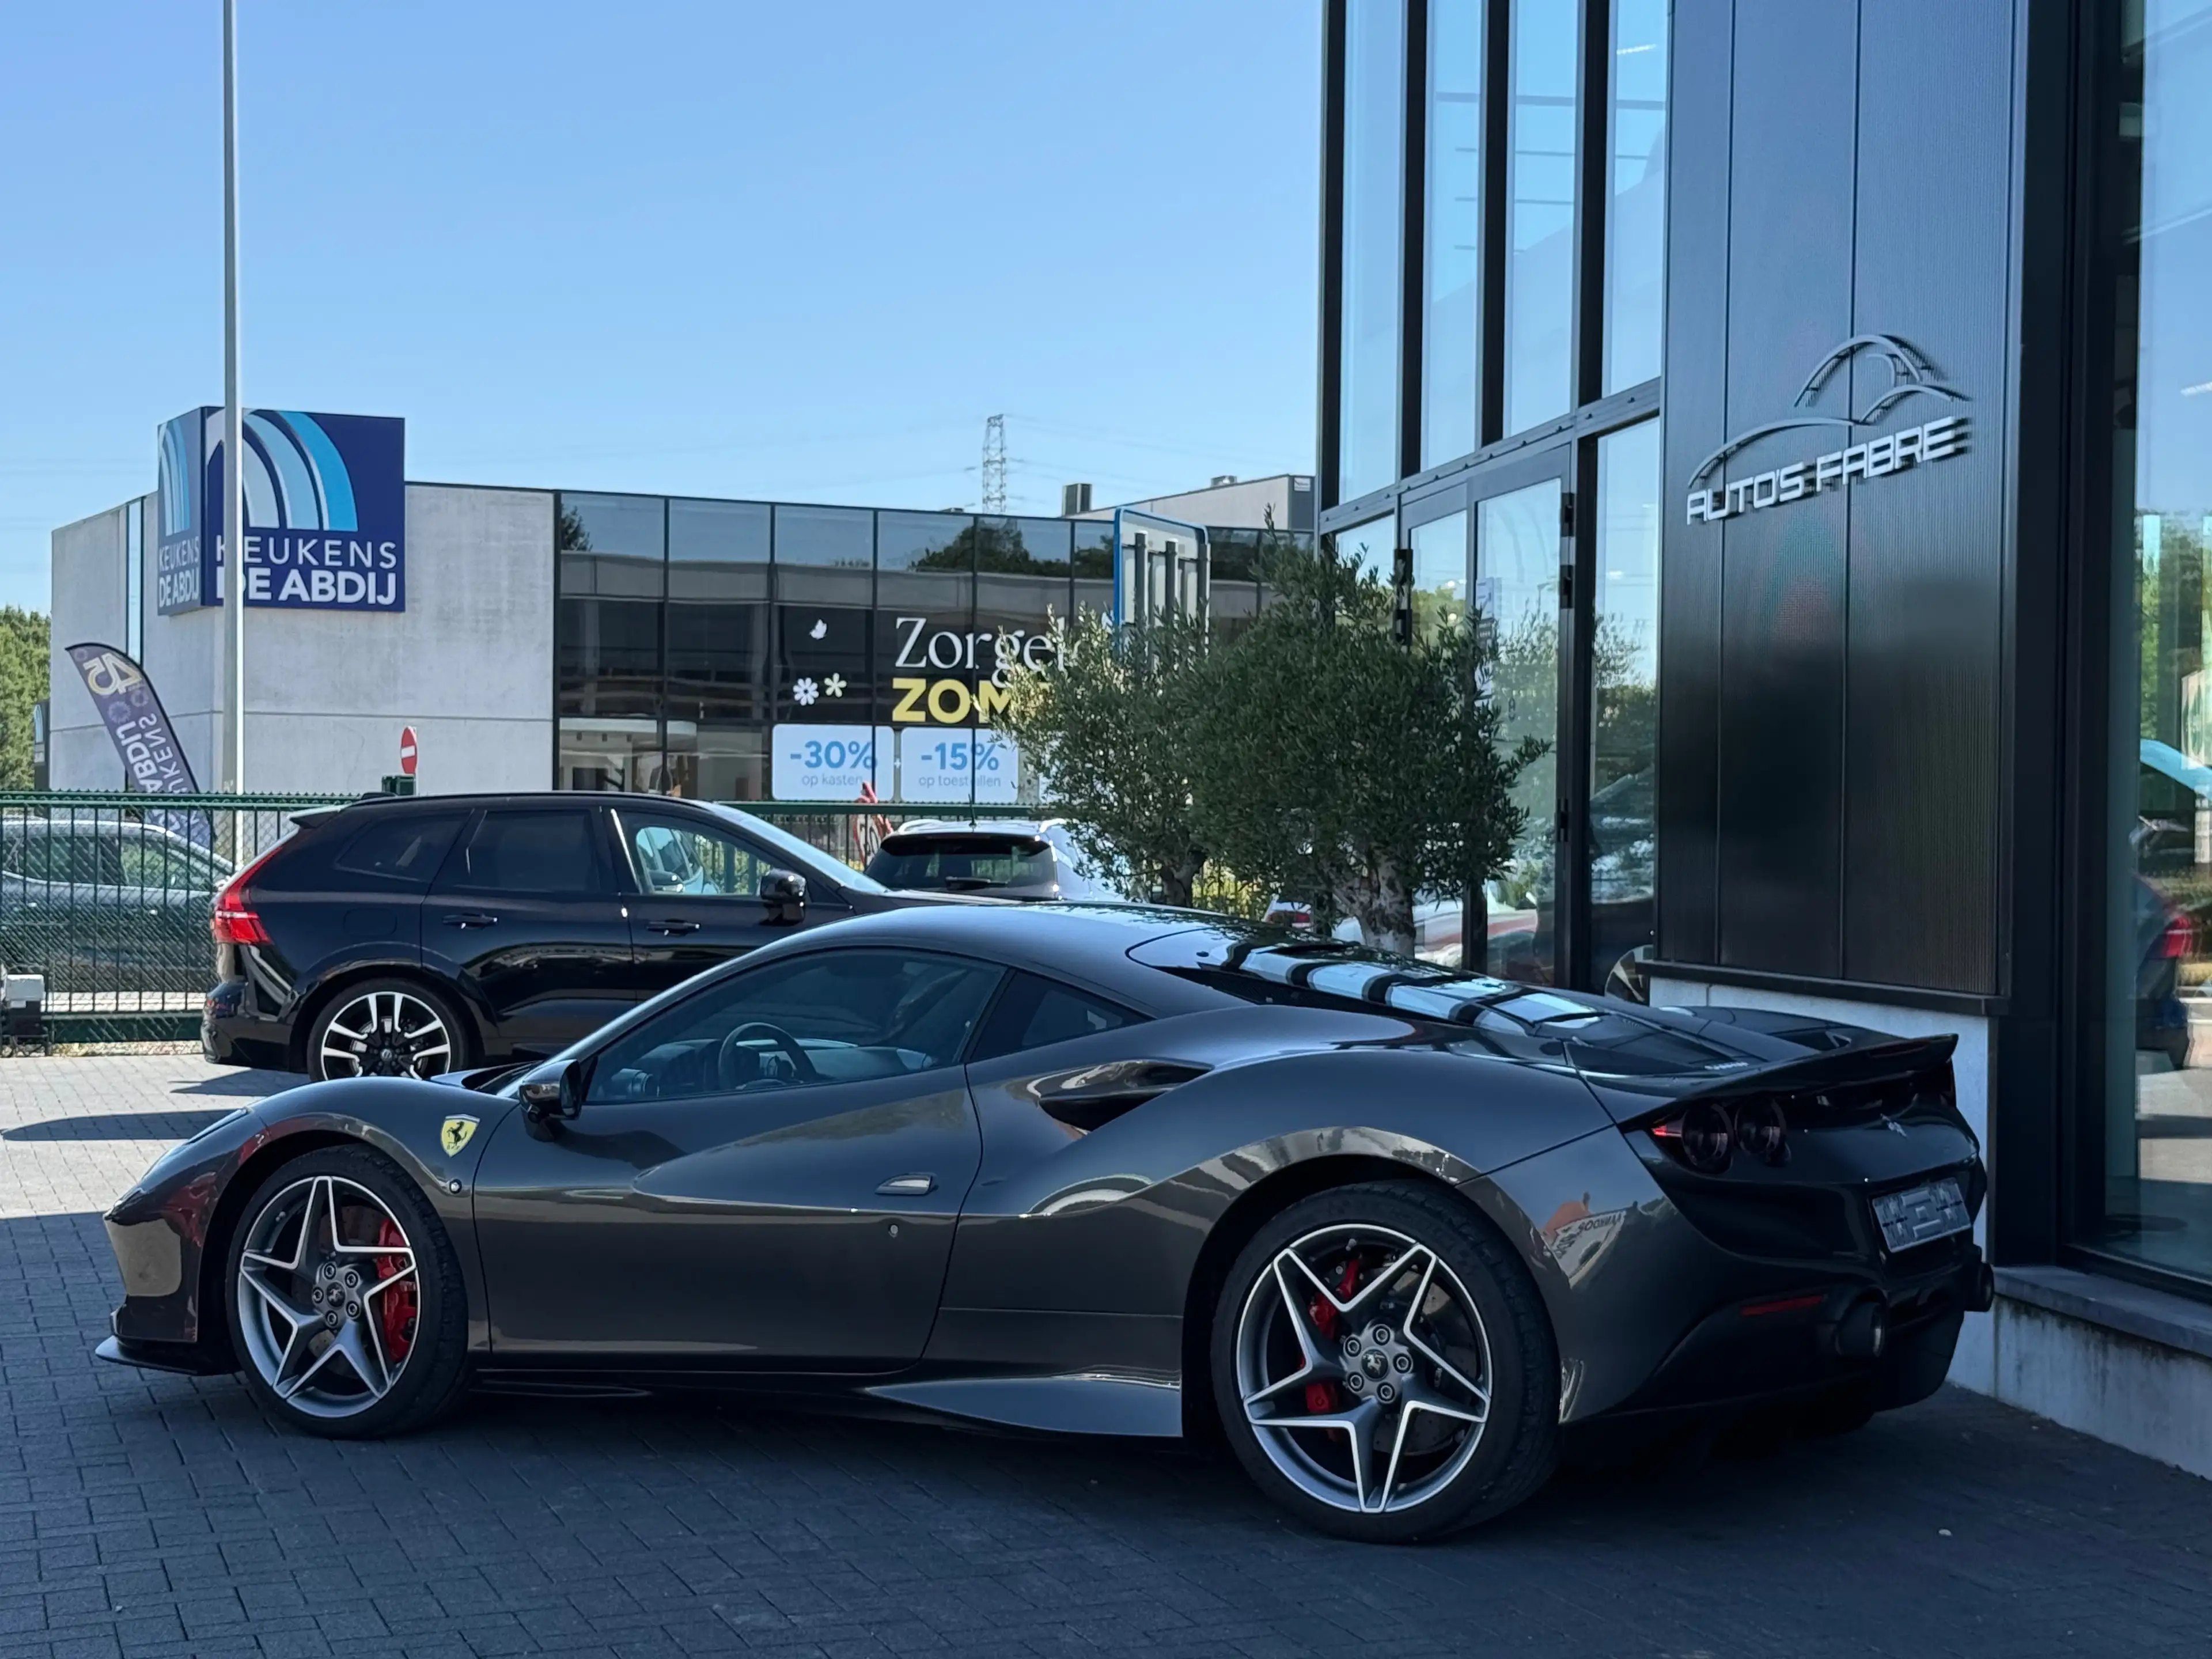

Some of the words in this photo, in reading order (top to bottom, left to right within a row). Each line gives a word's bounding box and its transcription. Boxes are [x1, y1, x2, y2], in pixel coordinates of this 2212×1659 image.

[1687, 462, 1805, 525] AUTO'S
[1816, 416, 1956, 492] FABRE
[160, 536, 199, 571] KEUKENS
[159, 575, 172, 608] DE
[173, 566, 199, 605] ABDIJ
[278, 569, 396, 605] ABDIJ
[790, 741, 878, 770] -30%
[921, 742, 999, 771] -15%
[801, 776, 819, 789] op
[822, 774, 863, 786] kasten
[919, 776, 935, 788] op
